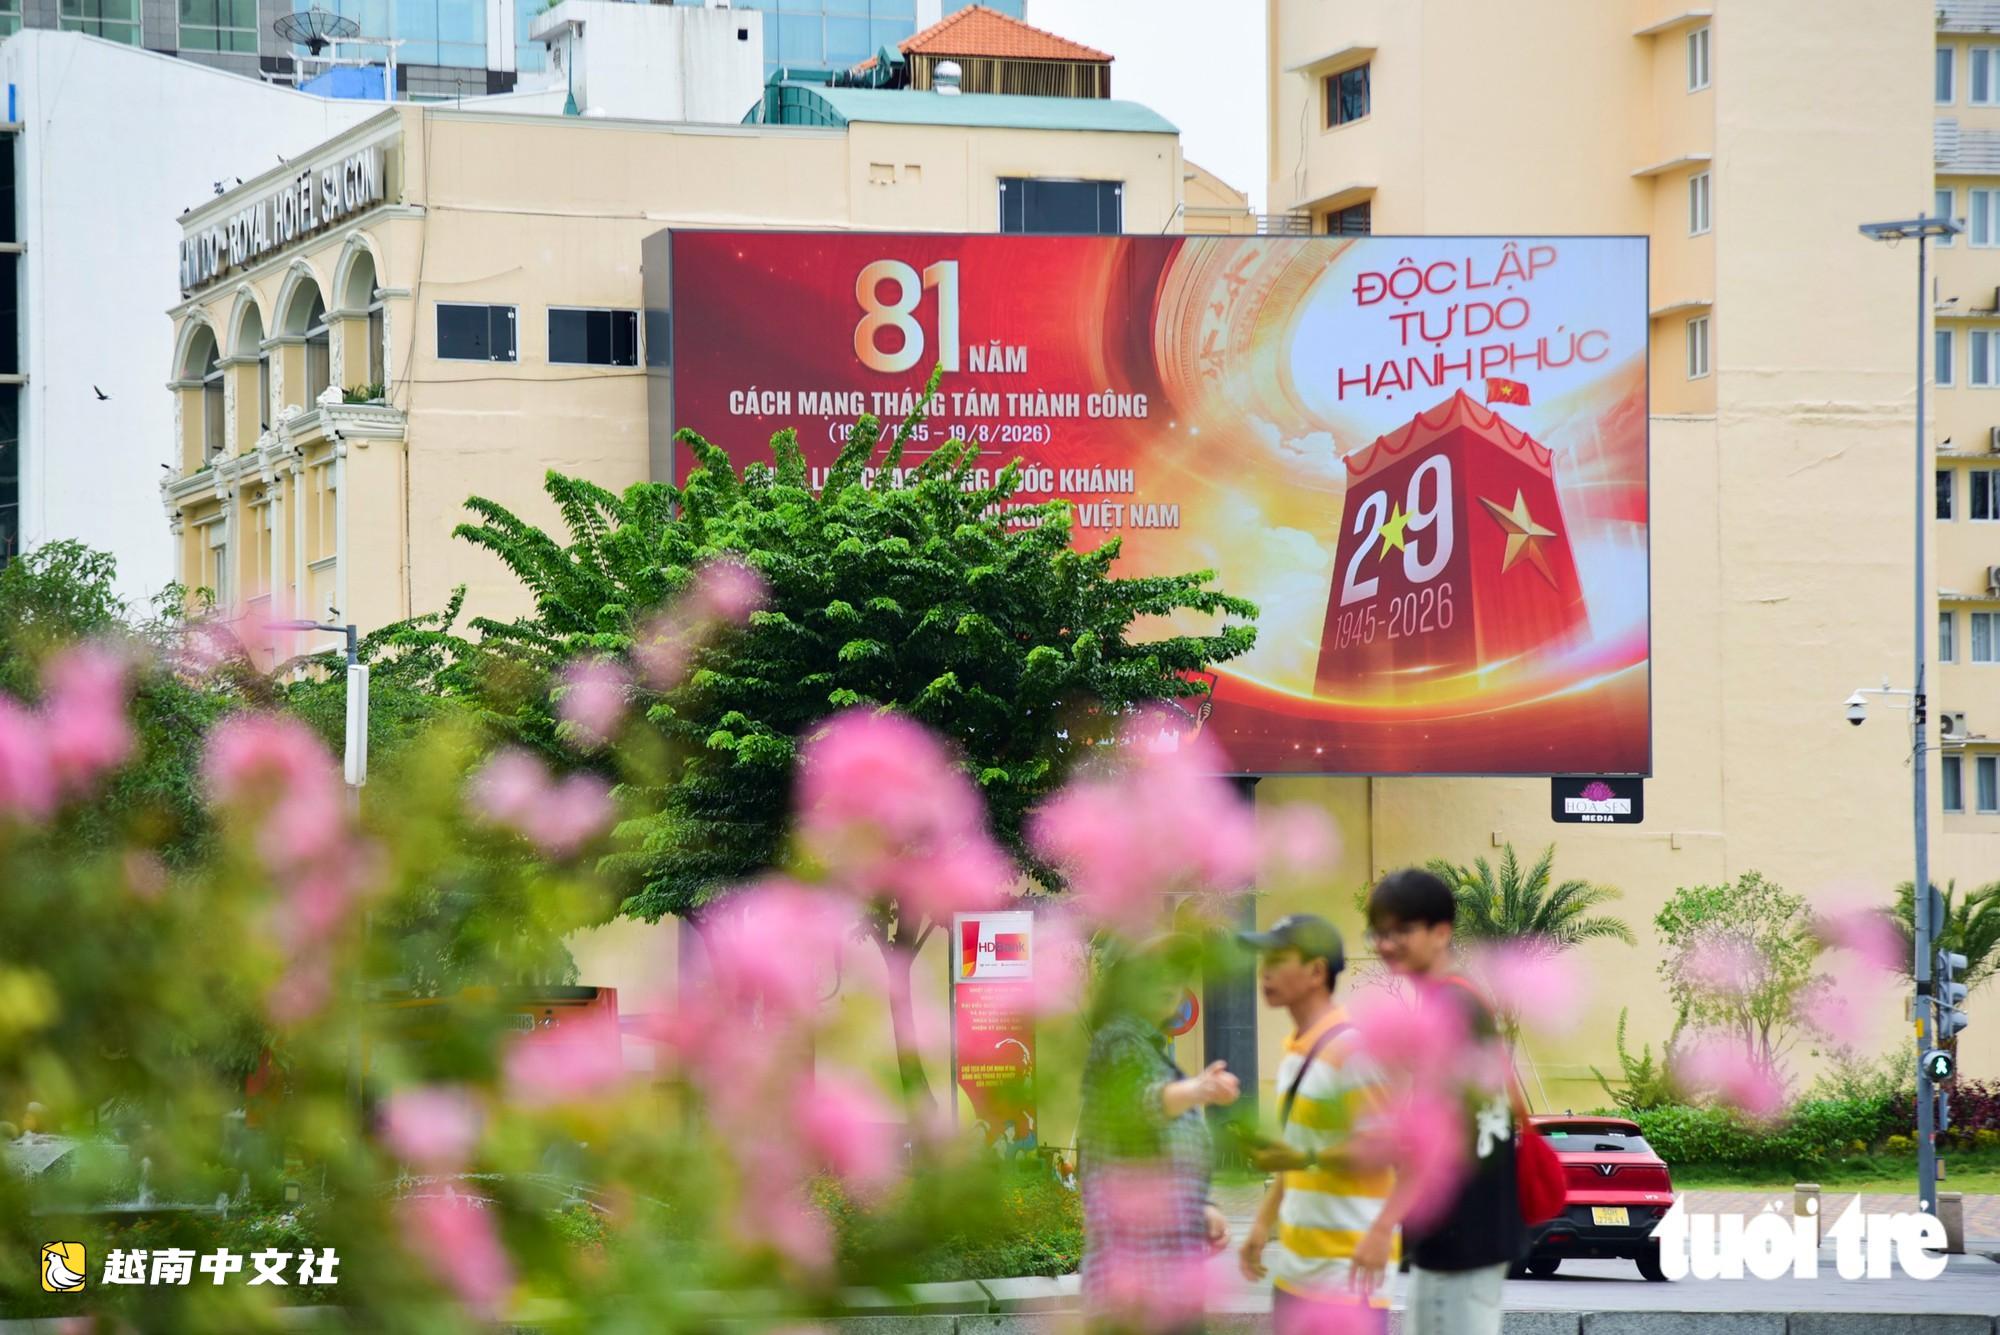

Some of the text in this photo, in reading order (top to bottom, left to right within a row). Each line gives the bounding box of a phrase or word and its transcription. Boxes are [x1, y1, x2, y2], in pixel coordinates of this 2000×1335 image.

[229, 201, 271, 266] ROYAL
[274, 177, 319, 246] HOTEL
[1352, 242, 1557, 307] ĐỘC LẬP
[854, 259, 1028, 373] 81 NĂM
[1389, 297, 1530, 348] TỰ DO
[1338, 325, 1610, 401] HẠNH PHÚC
[729, 386, 1149, 421] CÁCH MẠNG THÁNG TÁM THÀNH CÔNG
[1060, 464, 1134, 493] KHÁNH
[1078, 498, 1125, 532] VIỆT
[1130, 503, 1180, 528] NAM
[1334, 582, 1454, 650] 1945-2026
[1566, 801, 1598, 813] HOA
[1581, 814, 1614, 822] MEDIA
